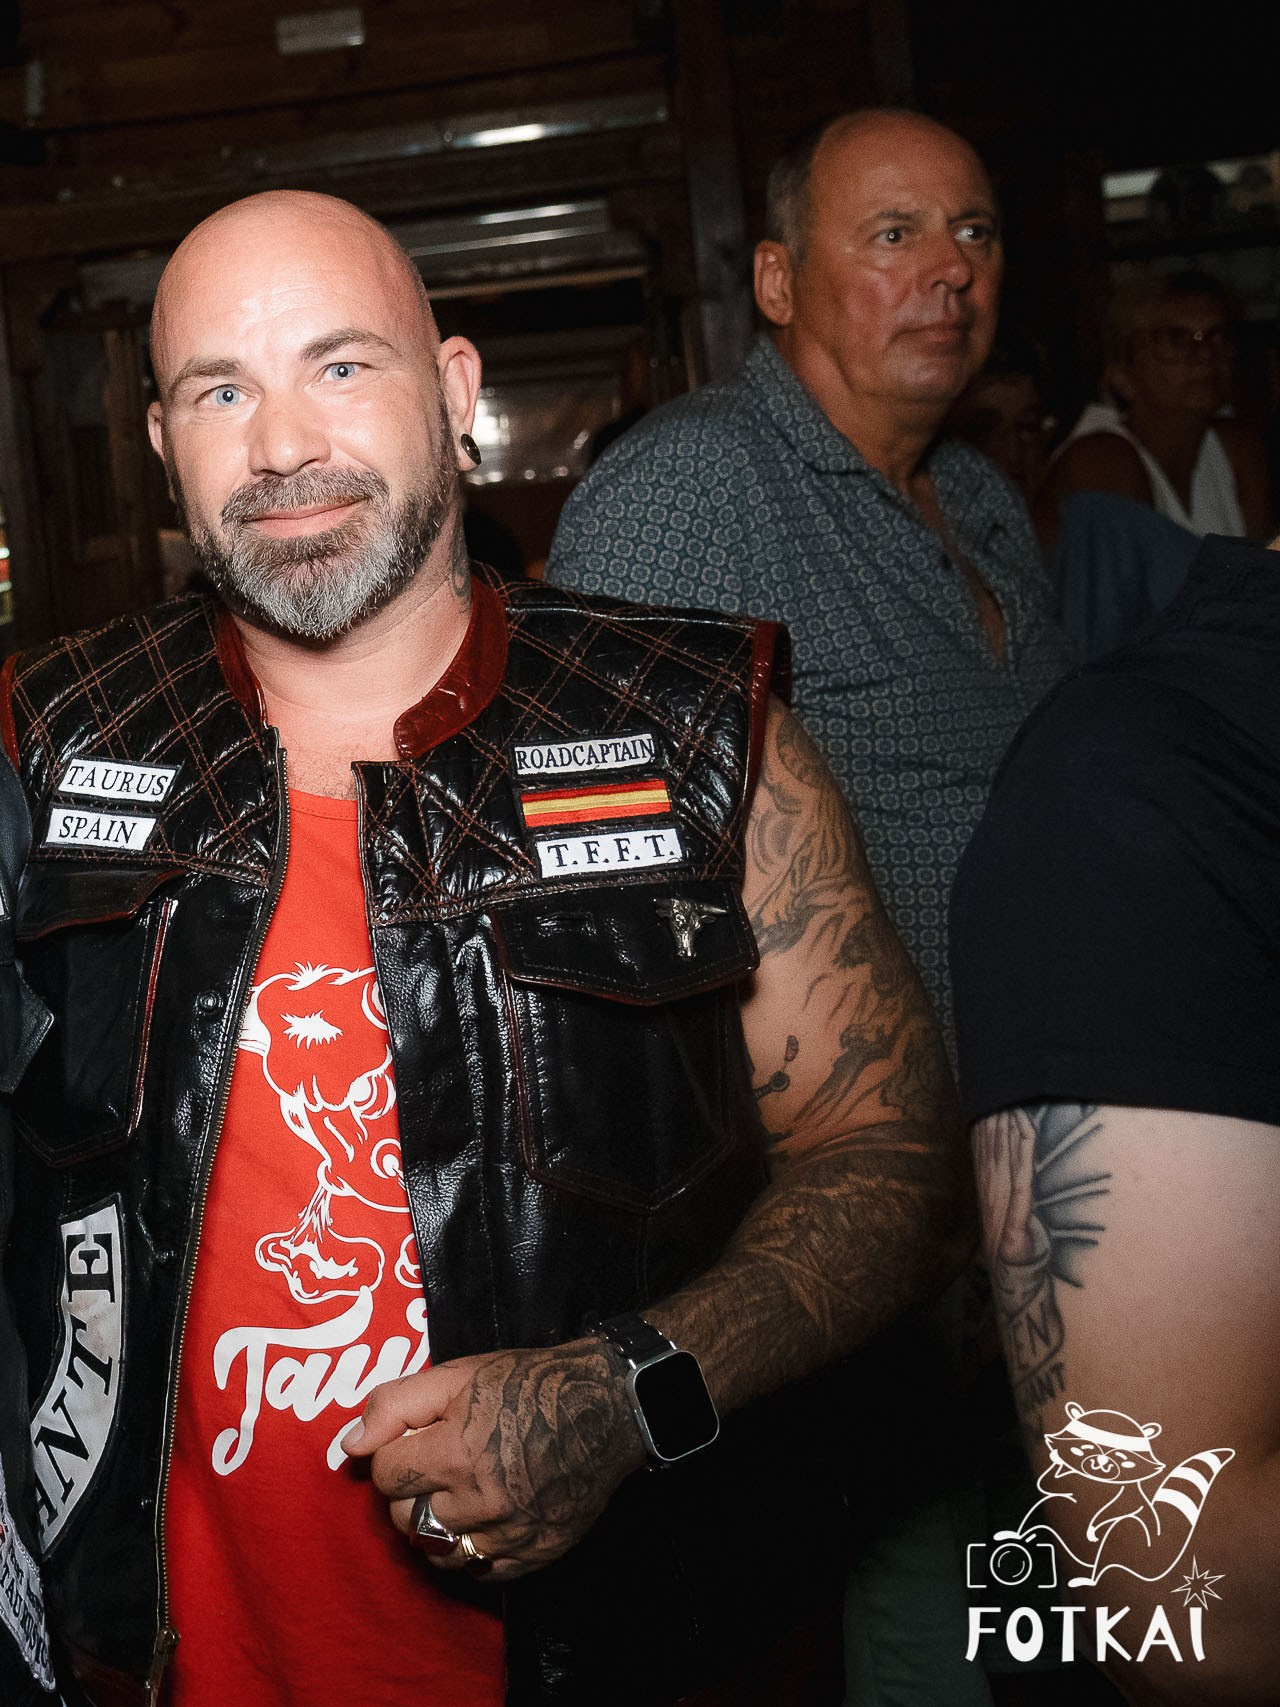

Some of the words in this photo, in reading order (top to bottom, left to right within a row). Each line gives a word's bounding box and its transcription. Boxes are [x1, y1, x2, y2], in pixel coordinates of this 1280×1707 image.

[517, 738, 654, 770] ROADCAPTAIN
[67, 765, 169, 796] TAURUS
[58, 815, 138, 844] SPAIN
